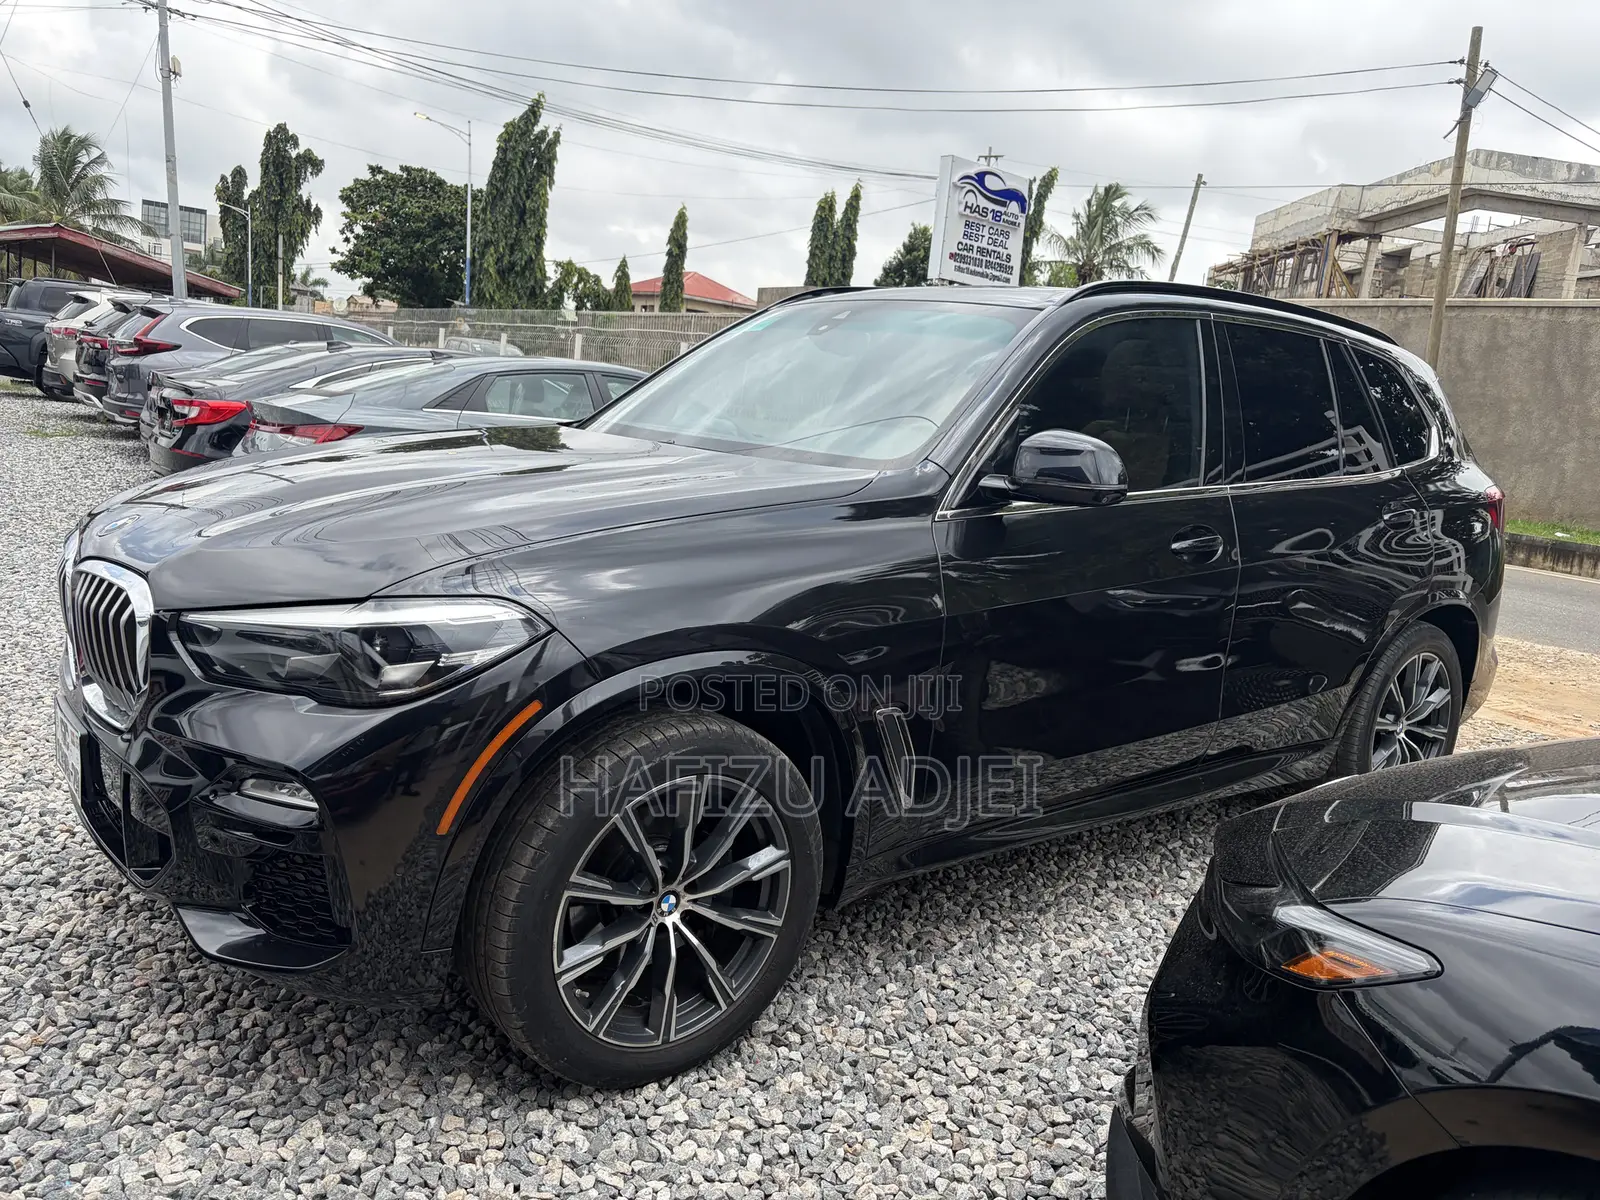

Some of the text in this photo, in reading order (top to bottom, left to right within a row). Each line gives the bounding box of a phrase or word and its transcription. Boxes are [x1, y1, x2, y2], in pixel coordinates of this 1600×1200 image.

[963, 201, 1003, 222] HAS 18
[1003, 211, 1019, 220] AUTO
[964, 220, 1010, 239] BEST CARS
[962, 231, 1008, 250] BEST DEAL
[957, 242, 1011, 263] CAR RENTALS
